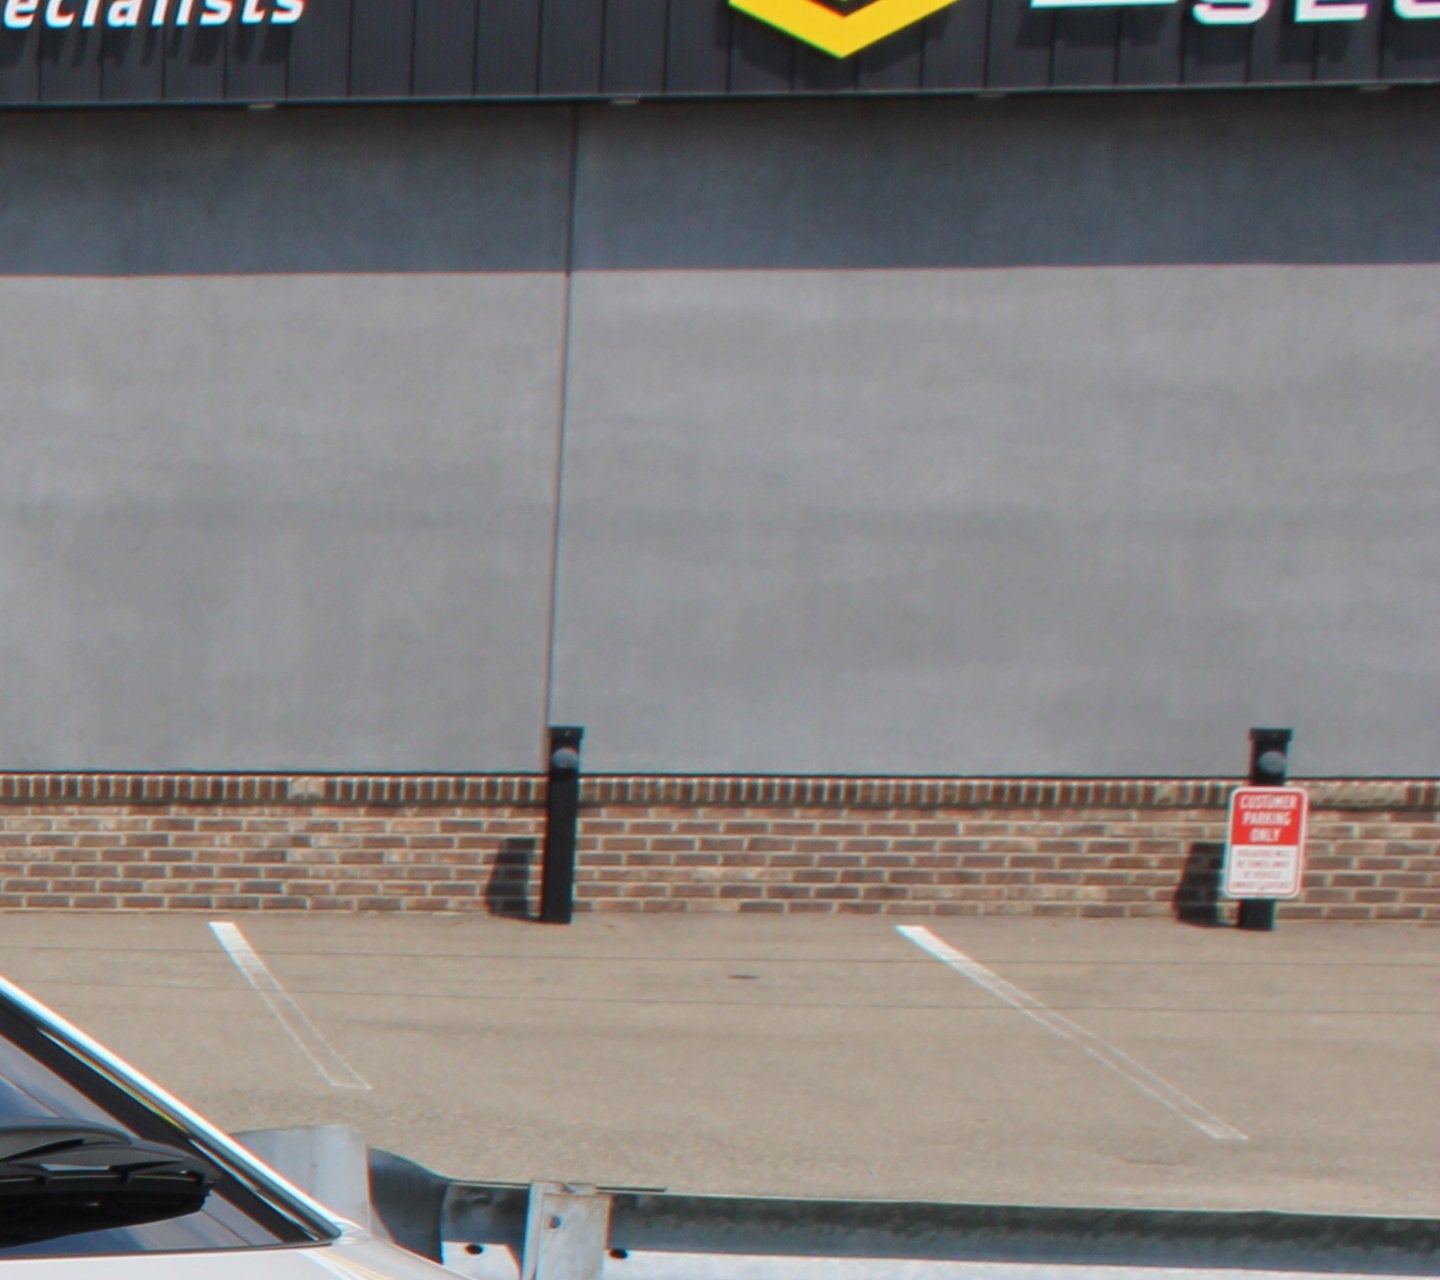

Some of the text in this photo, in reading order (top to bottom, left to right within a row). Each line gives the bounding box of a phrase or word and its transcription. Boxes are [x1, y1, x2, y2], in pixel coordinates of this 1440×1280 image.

[1240, 795, 1298, 809] CUSTOMER
[1242, 811, 1292, 826] PARKING
[1250, 827, 1282, 843] ONLY
